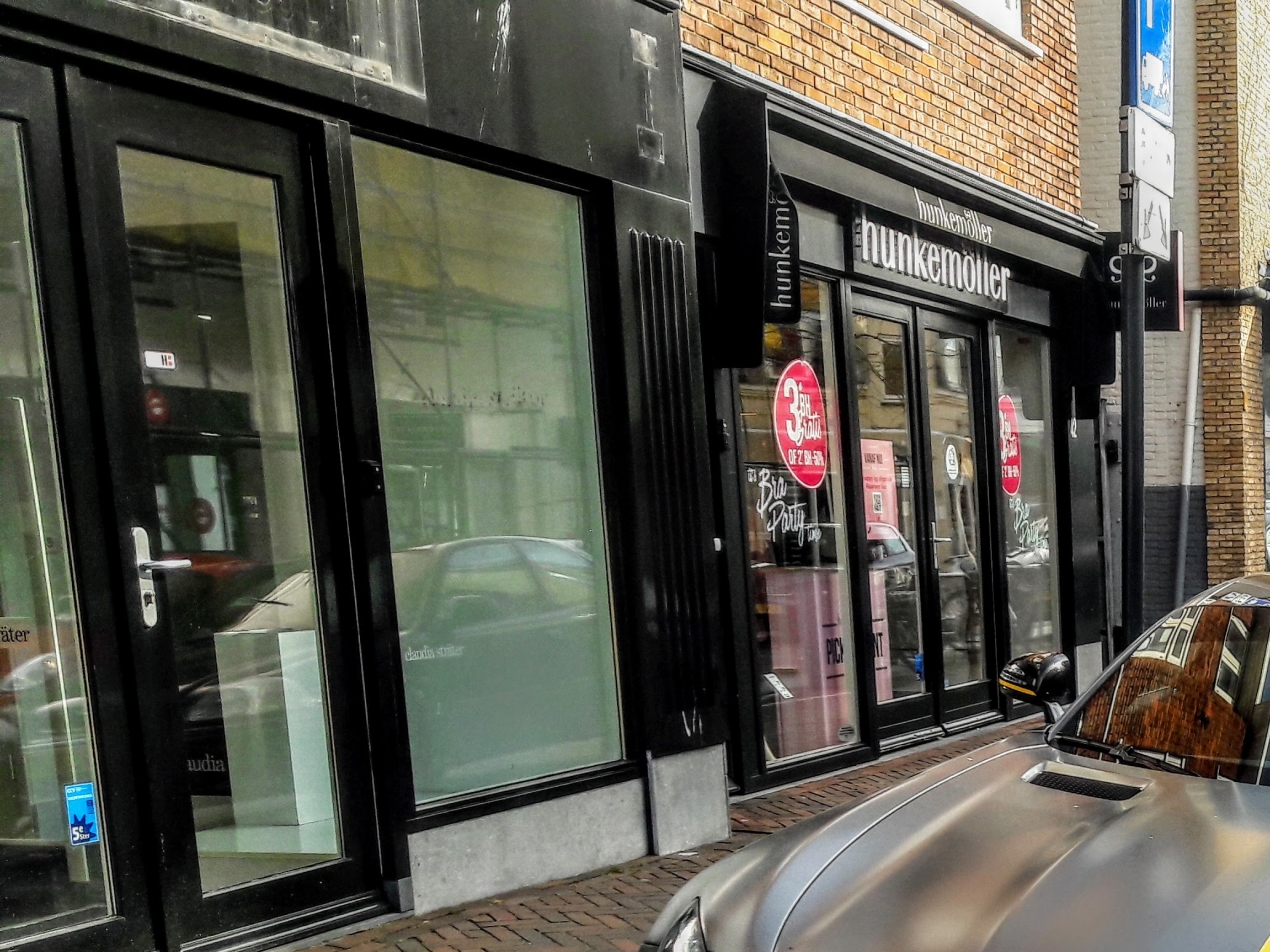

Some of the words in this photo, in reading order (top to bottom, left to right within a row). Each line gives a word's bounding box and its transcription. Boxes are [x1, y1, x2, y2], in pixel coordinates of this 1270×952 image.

[913, 188, 993, 244] hunkemöller
[861, 216, 1011, 302] hunkemöller
[757, 468, 788, 519] Bra
[767, 500, 808, 547] Party
[0, 626, 30, 642] äter
